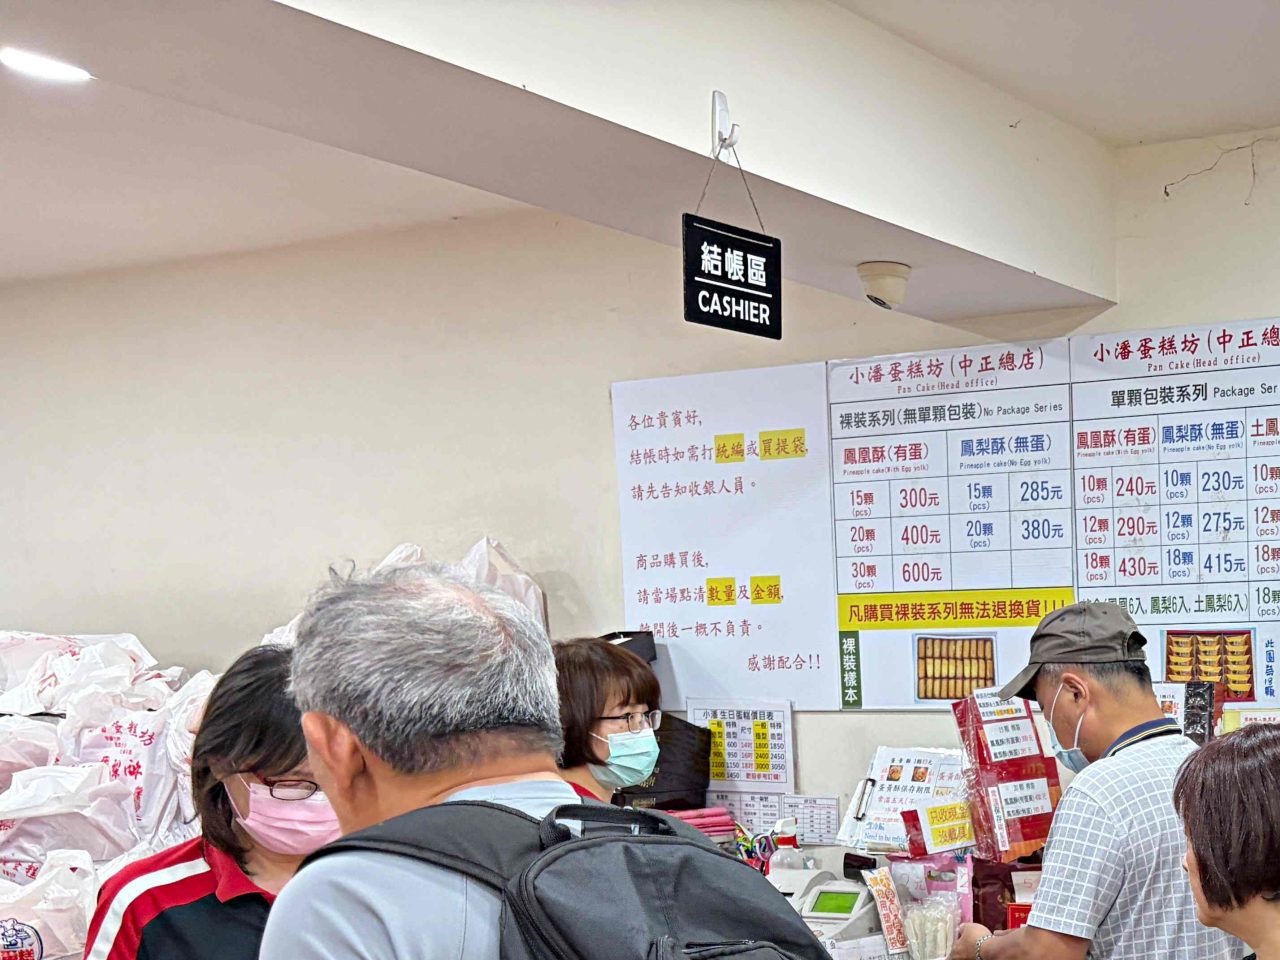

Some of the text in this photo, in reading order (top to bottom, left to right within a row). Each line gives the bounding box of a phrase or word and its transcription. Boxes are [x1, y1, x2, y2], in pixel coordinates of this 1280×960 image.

[701, 241, 767, 287] 結帳區
[698, 290, 770, 325] CASHIER
[849, 347, 1044, 384] 小潘蛋糕坊(中正總店)
[1148, 362, 1163, 372] Pan
[1223, 352, 1261, 365] office)
[1111, 382, 1208, 408] 單顆包裝系列
[1213, 385, 1255, 398] Package
[997, 404, 1030, 416] Package
[1034, 402, 1063, 412] Series
[1076, 427, 1156, 450] 鳳凰酥(有蛋)
[1162, 420, 1245, 444] 鳳梨酥(無蛋)
[844, 442, 929, 465] 鳳凰酥(有蛋)
[960, 434, 1052, 458] 鳳梨酥(無蛋)
[1081, 475, 1157, 497] 10顆 240元
[1163, 469, 1244, 492] 10顆 230元
[1255, 483, 1278, 494] (pcs)
[850, 488, 940, 509] 15顆 300元
[967, 480, 1063, 502] 15顆 285元
[1083, 494, 1105, 504] (pcs)
[1166, 489, 1188, 500] (pcs)
[852, 508, 872, 518] (pcs)
[969, 501, 990, 511] (pcs)
[966, 519, 1064, 540] 20顆 380元
[1083, 515, 1158, 537] 12顆 290元
[1165, 511, 1245, 533] 12顆 275元
[1256, 525, 1279, 536] (pcs)
[850, 525, 941, 545] 20顆 400元
[969, 539, 991, 549] (pcs)
[1085, 535, 1107, 545] (pcs)
[1167, 530, 1190, 541] (pcs)
[854, 543, 874, 553] (pcs)
[1084, 552, 1159, 577] 18顆 430元
[1167, 548, 1246, 574] 18顆 415元
[1257, 564, 1280, 574] (pcs)
[852, 562, 942, 582] 30顆 600元
[1086, 571, 1108, 582] (pcs)
[1168, 567, 1191, 578] (pcs)
[855, 580, 874, 590] (pcs)
[1257, 606, 1280, 617] (pcs)
[748, 654, 821, 671] 感謝配合!!
[842, 638, 858, 704] 裸裝樣本
